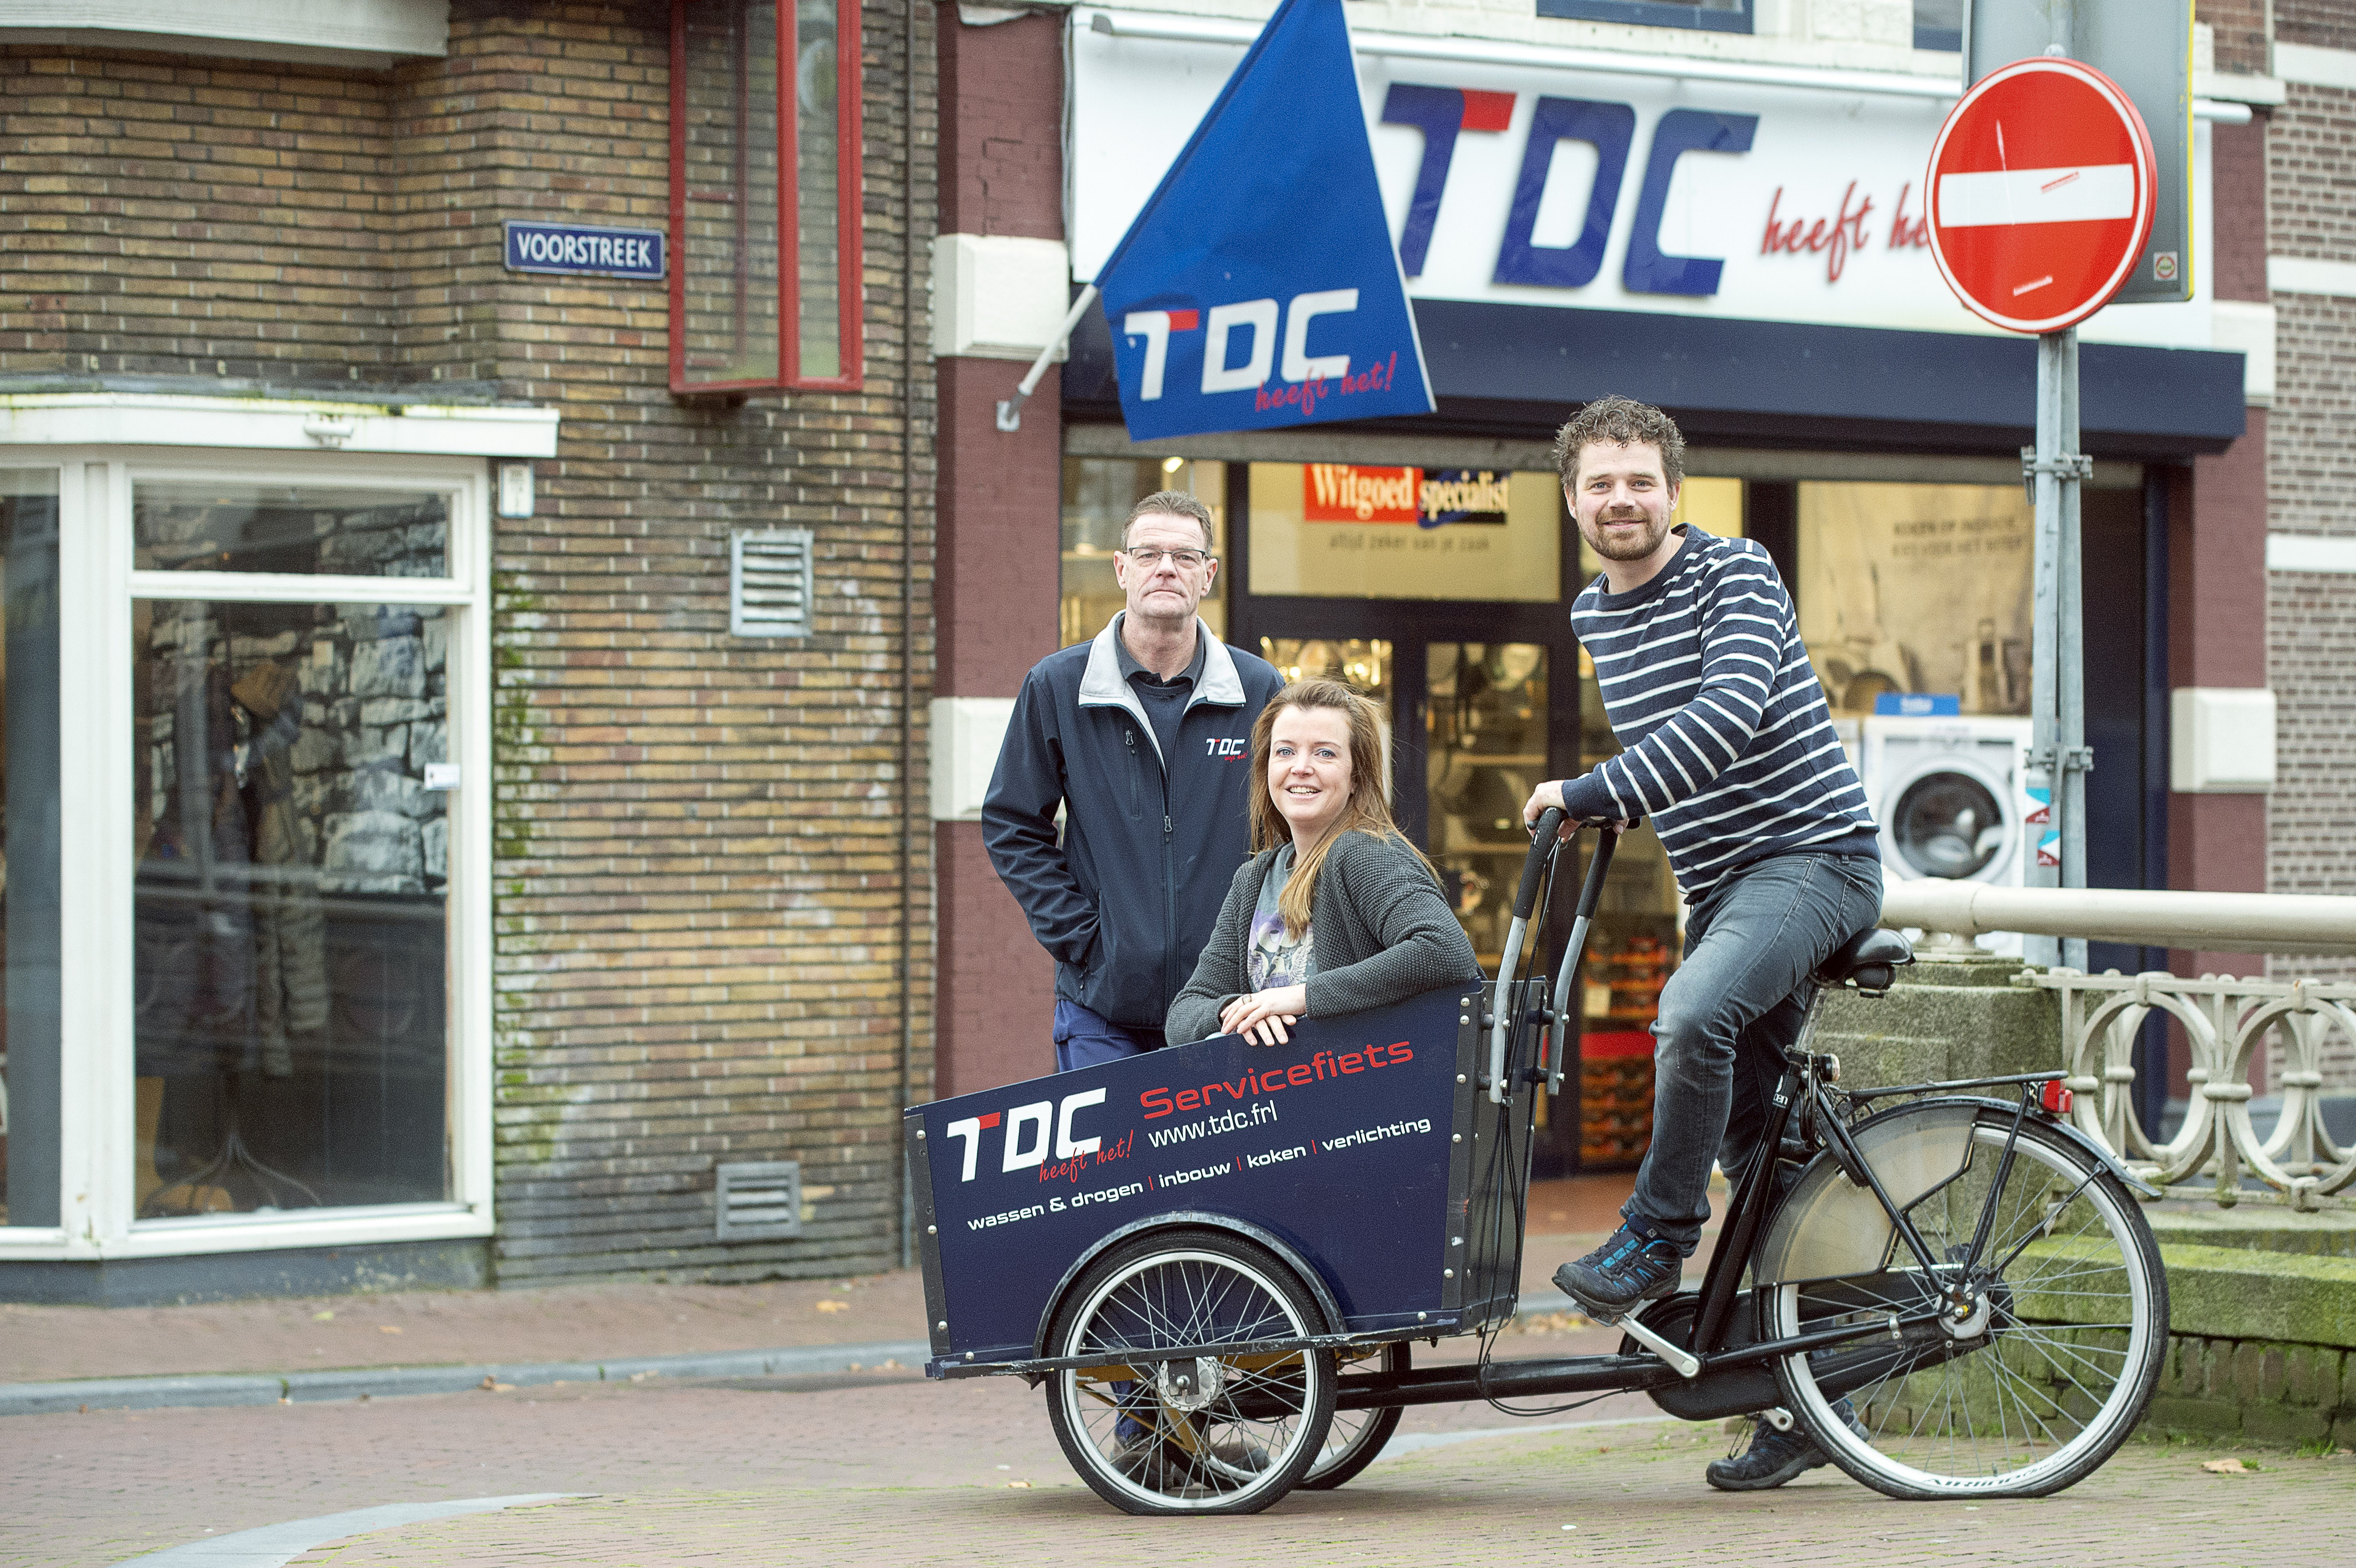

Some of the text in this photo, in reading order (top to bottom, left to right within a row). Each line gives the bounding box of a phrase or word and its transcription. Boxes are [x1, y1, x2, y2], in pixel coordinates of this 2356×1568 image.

[1380, 83, 1760, 297] TDC
[516, 232, 653, 269] VOORSTREEK
[1760, 179, 1874, 283] heeft
[1124, 288, 1359, 402] TDC
[1255, 351, 1398, 416] heeft het!
[1311, 464, 1510, 522] Witgoed specialist
[1206, 738, 1245, 756] TDC
[1140, 1040, 1414, 1119] Servicefiets
[947, 1087, 1107, 1182] TDC
[1039, 1129, 1134, 1183] heeft het!
[1148, 1099, 1278, 1148] www.tdc.frl
[967, 1118, 1432, 1231] wassen & drogen inbouw koken verlichting
